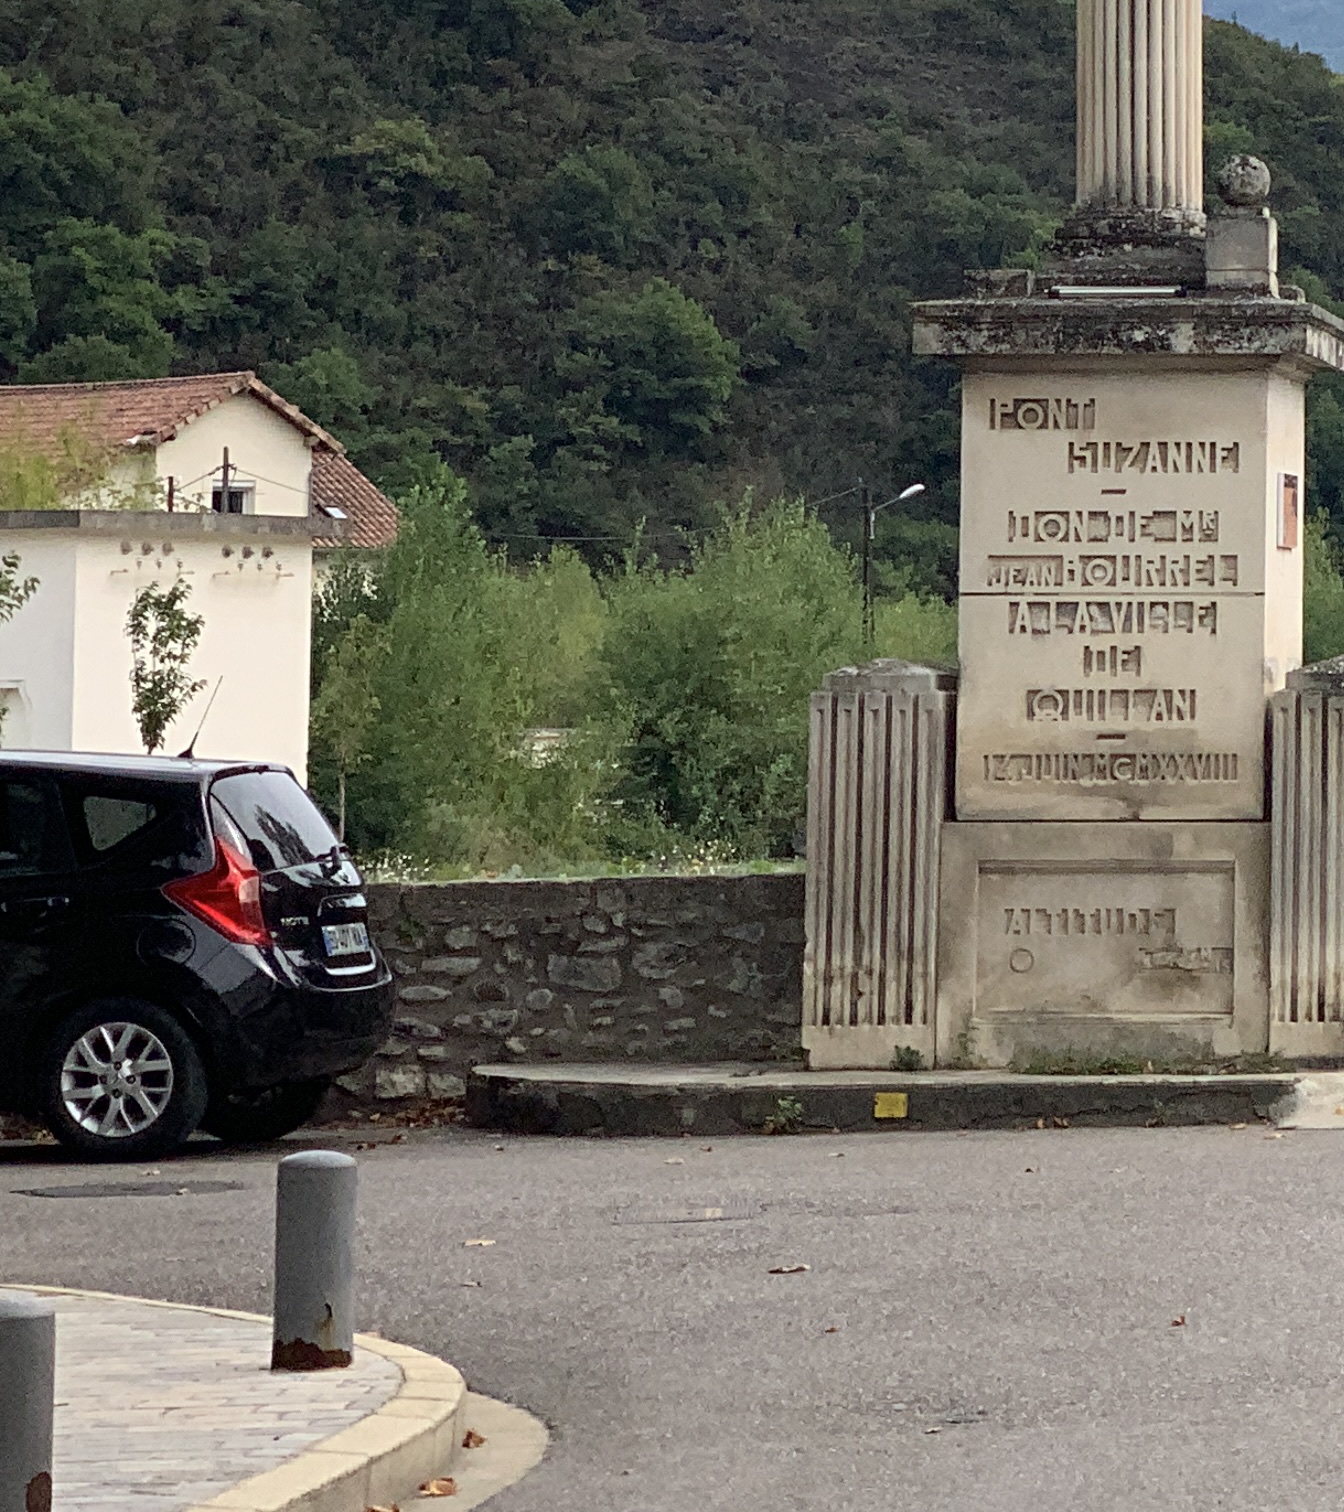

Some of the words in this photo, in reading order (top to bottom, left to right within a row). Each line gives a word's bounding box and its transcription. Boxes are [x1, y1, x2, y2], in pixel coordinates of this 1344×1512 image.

[989, 398, 1096, 430] PONT
[1068, 442, 1240, 473] SUZANNE
[1009, 510, 1084, 542] DON
[1108, 510, 1154, 542] DE
[1108, 601, 1217, 634] VILLE
[1084, 645, 1141, 677] DE
[1026, 688, 1196, 722] QUILLAN
